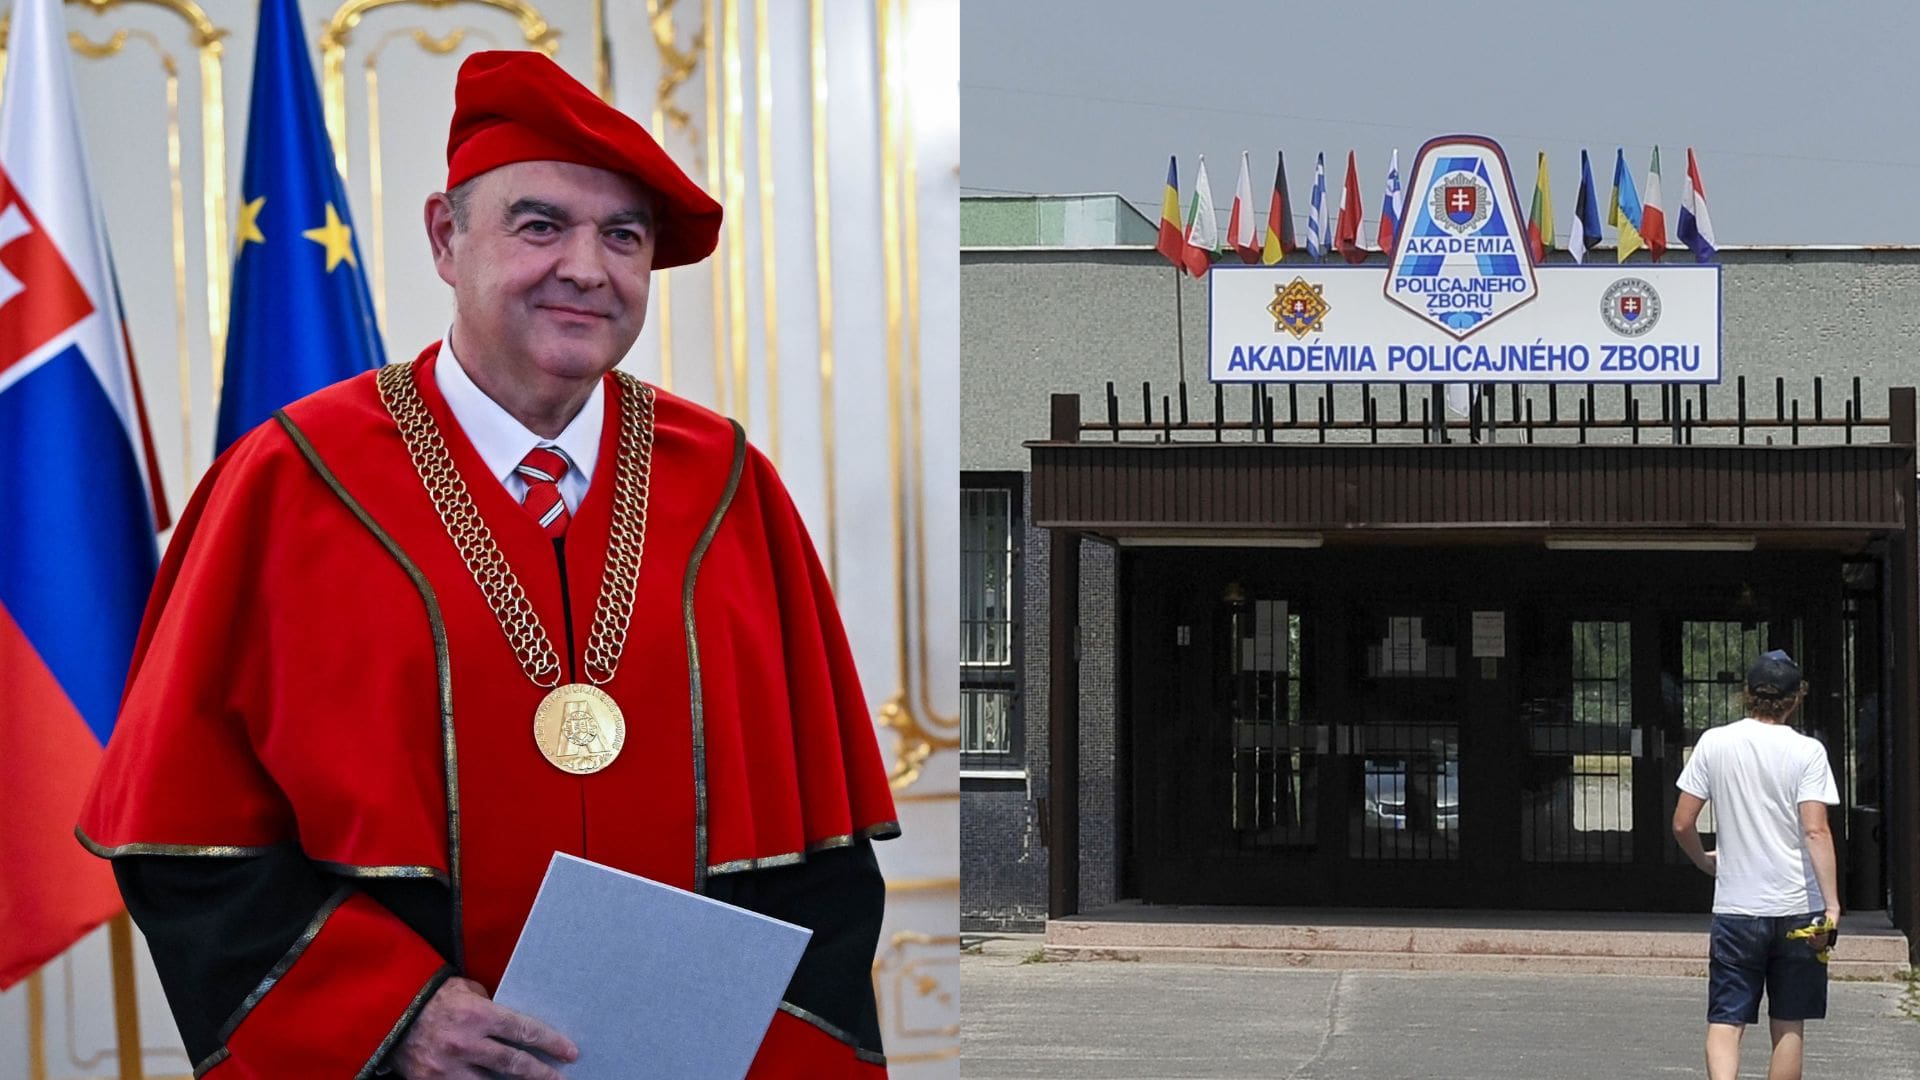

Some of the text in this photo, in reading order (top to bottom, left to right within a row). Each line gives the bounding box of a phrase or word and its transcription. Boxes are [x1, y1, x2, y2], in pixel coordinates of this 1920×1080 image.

[1405, 238, 1516, 253] AKADEMIA
[1395, 277, 1527, 293] POLICAJNEHO
[1426, 294, 1493, 309] ZBORU
[1227, 337, 1700, 371] AKADÉMIA POLICAJNÉHO ZBORU
